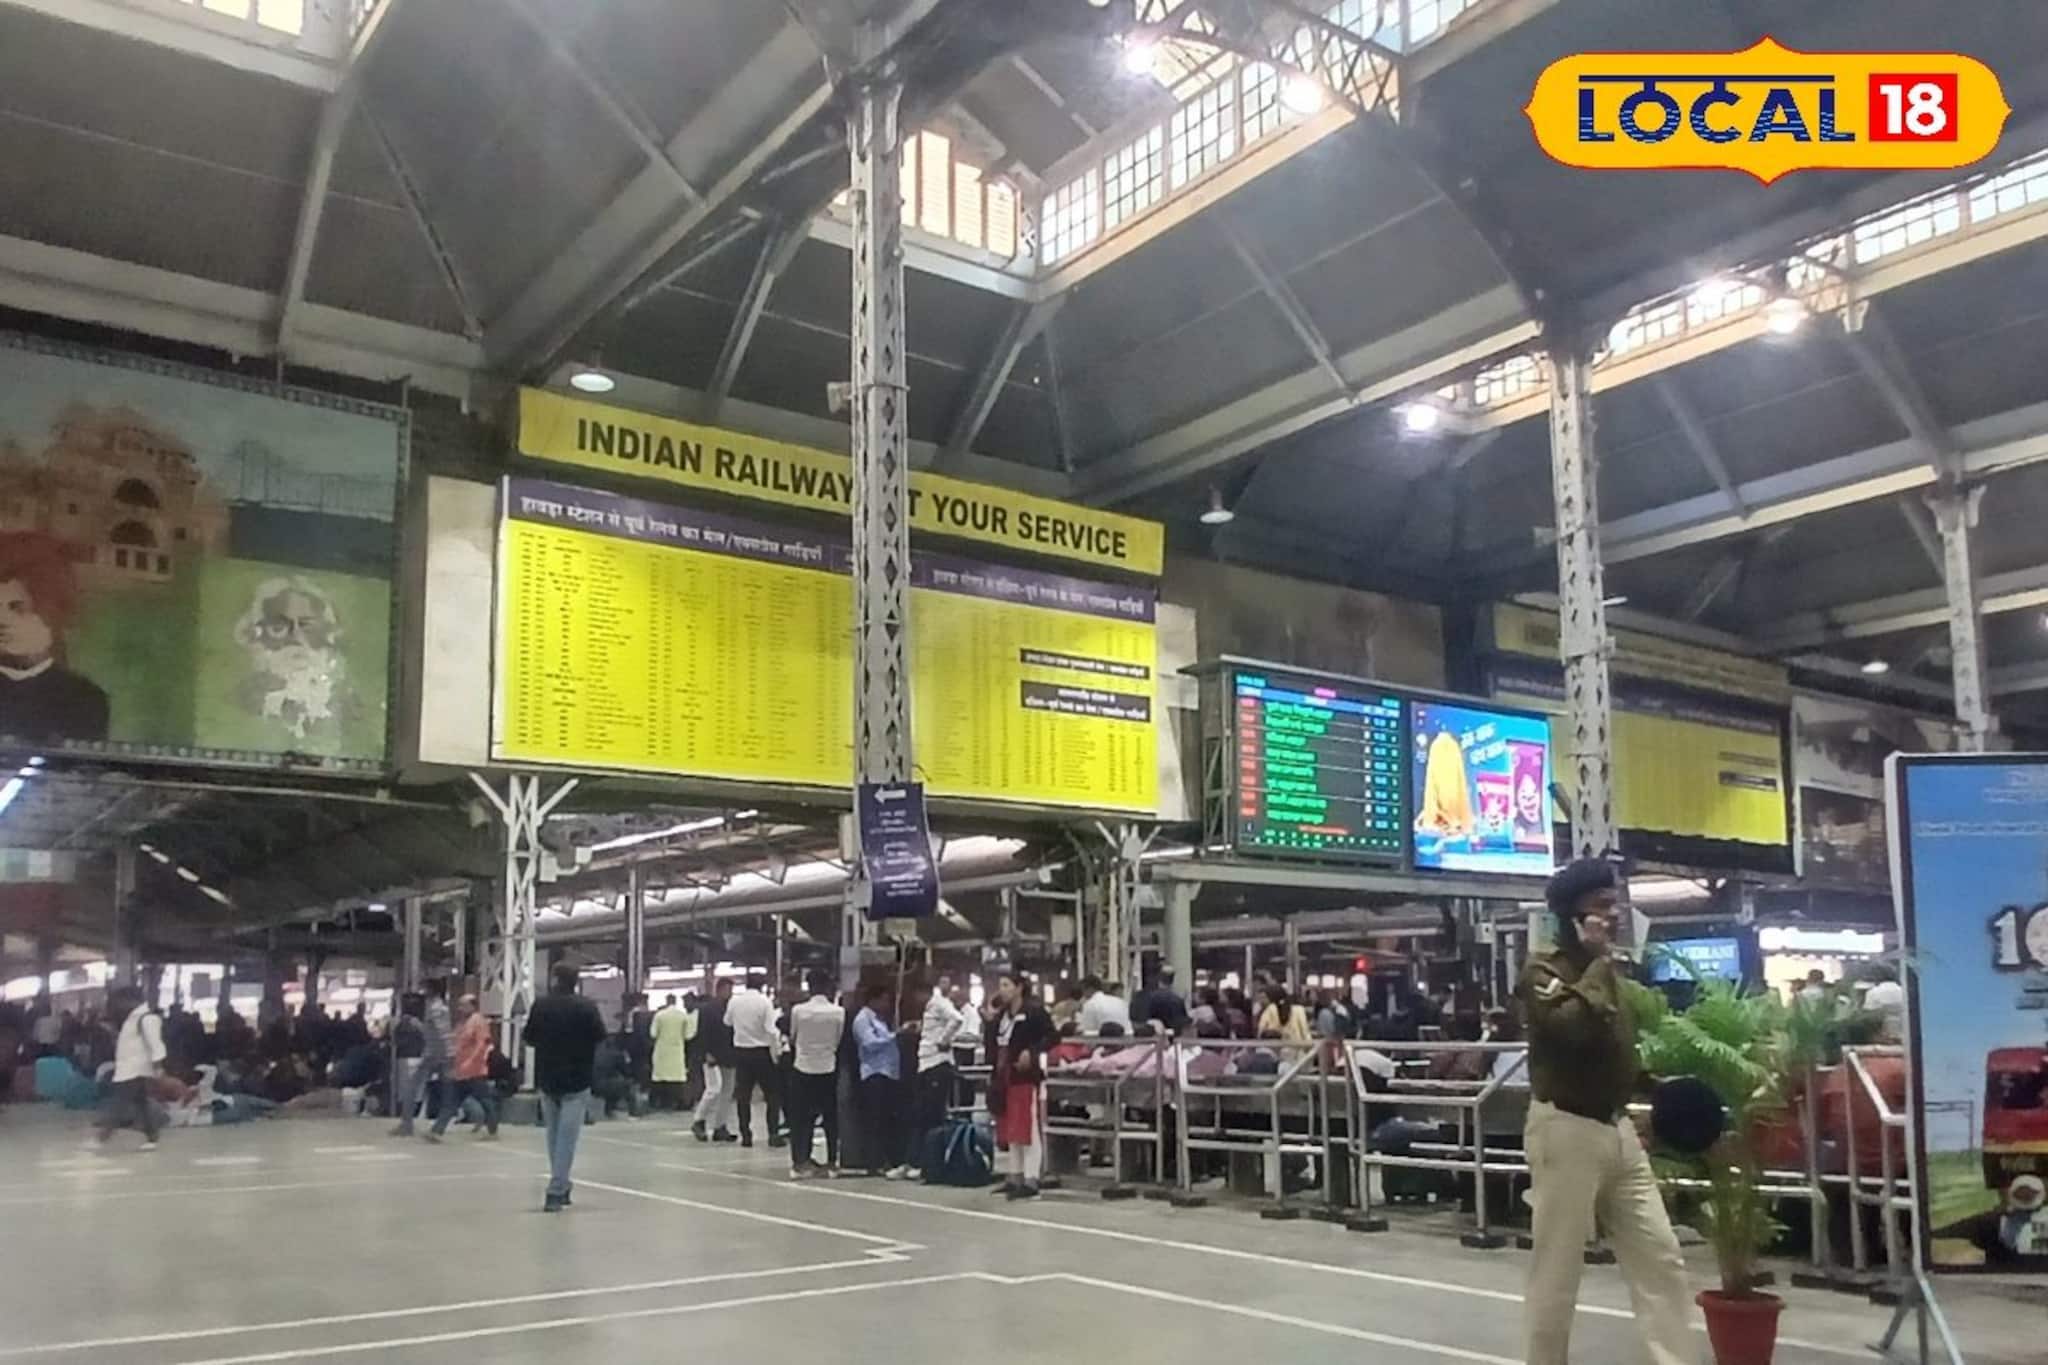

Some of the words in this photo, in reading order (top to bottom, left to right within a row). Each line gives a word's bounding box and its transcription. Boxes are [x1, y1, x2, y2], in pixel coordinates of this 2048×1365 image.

[577, 418, 703, 474] INDIAN
[715, 448, 855, 506] RAILWAY
[931, 494, 1008, 535] YOUR
[1017, 511, 1127, 559] SERVICE
